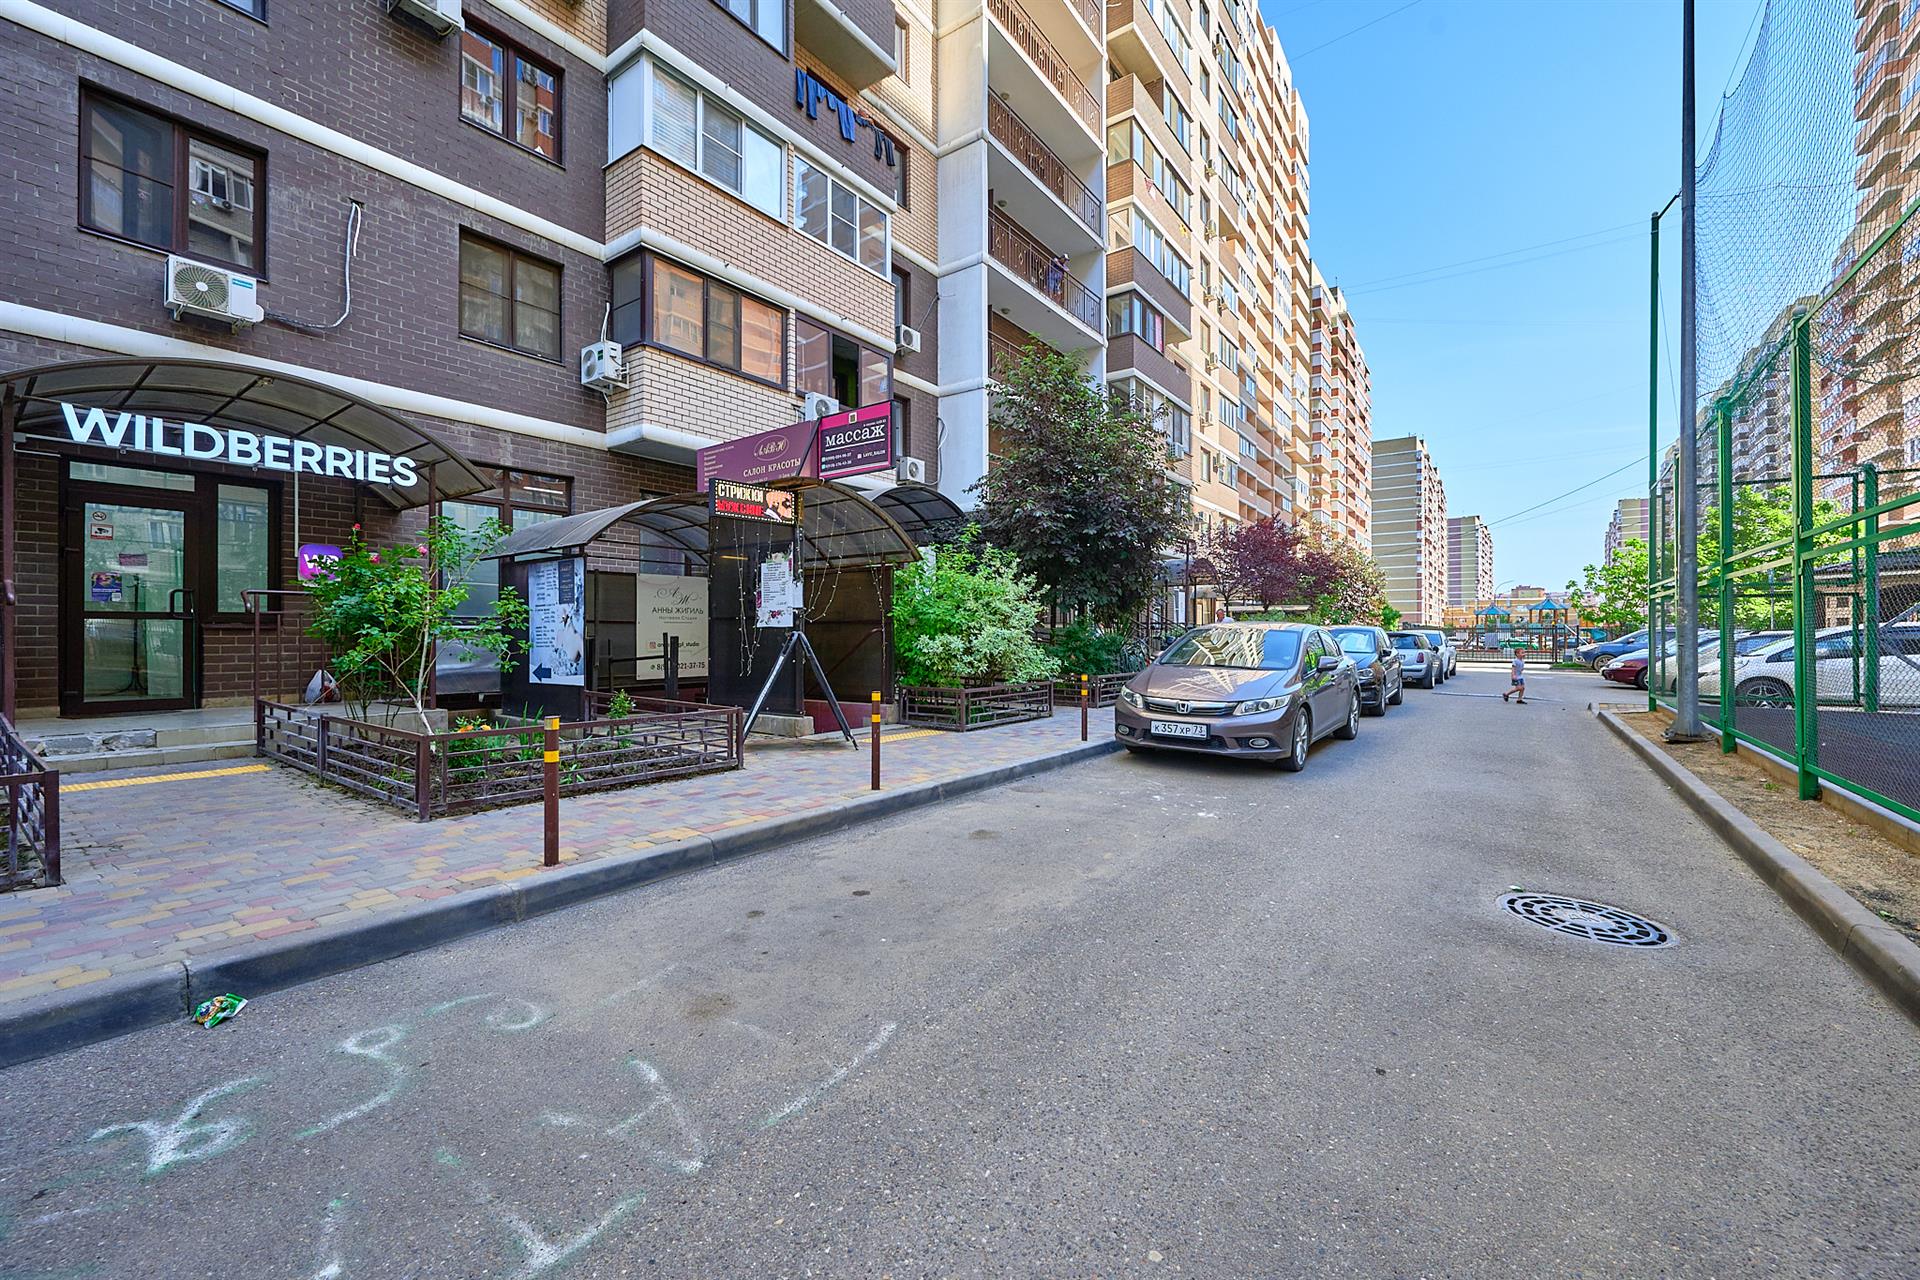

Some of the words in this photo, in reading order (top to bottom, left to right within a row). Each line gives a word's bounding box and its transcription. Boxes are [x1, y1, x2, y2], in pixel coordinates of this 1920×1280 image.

[61, 403, 418, 487] WILDBERRIES
[743, 466, 766, 477] САЛОН
[768, 458, 800, 472] КРАСОТЫ
[718, 484, 764, 502] СТРИЖКИ
[675, 607, 704, 615] ЖИГИЛЬ
